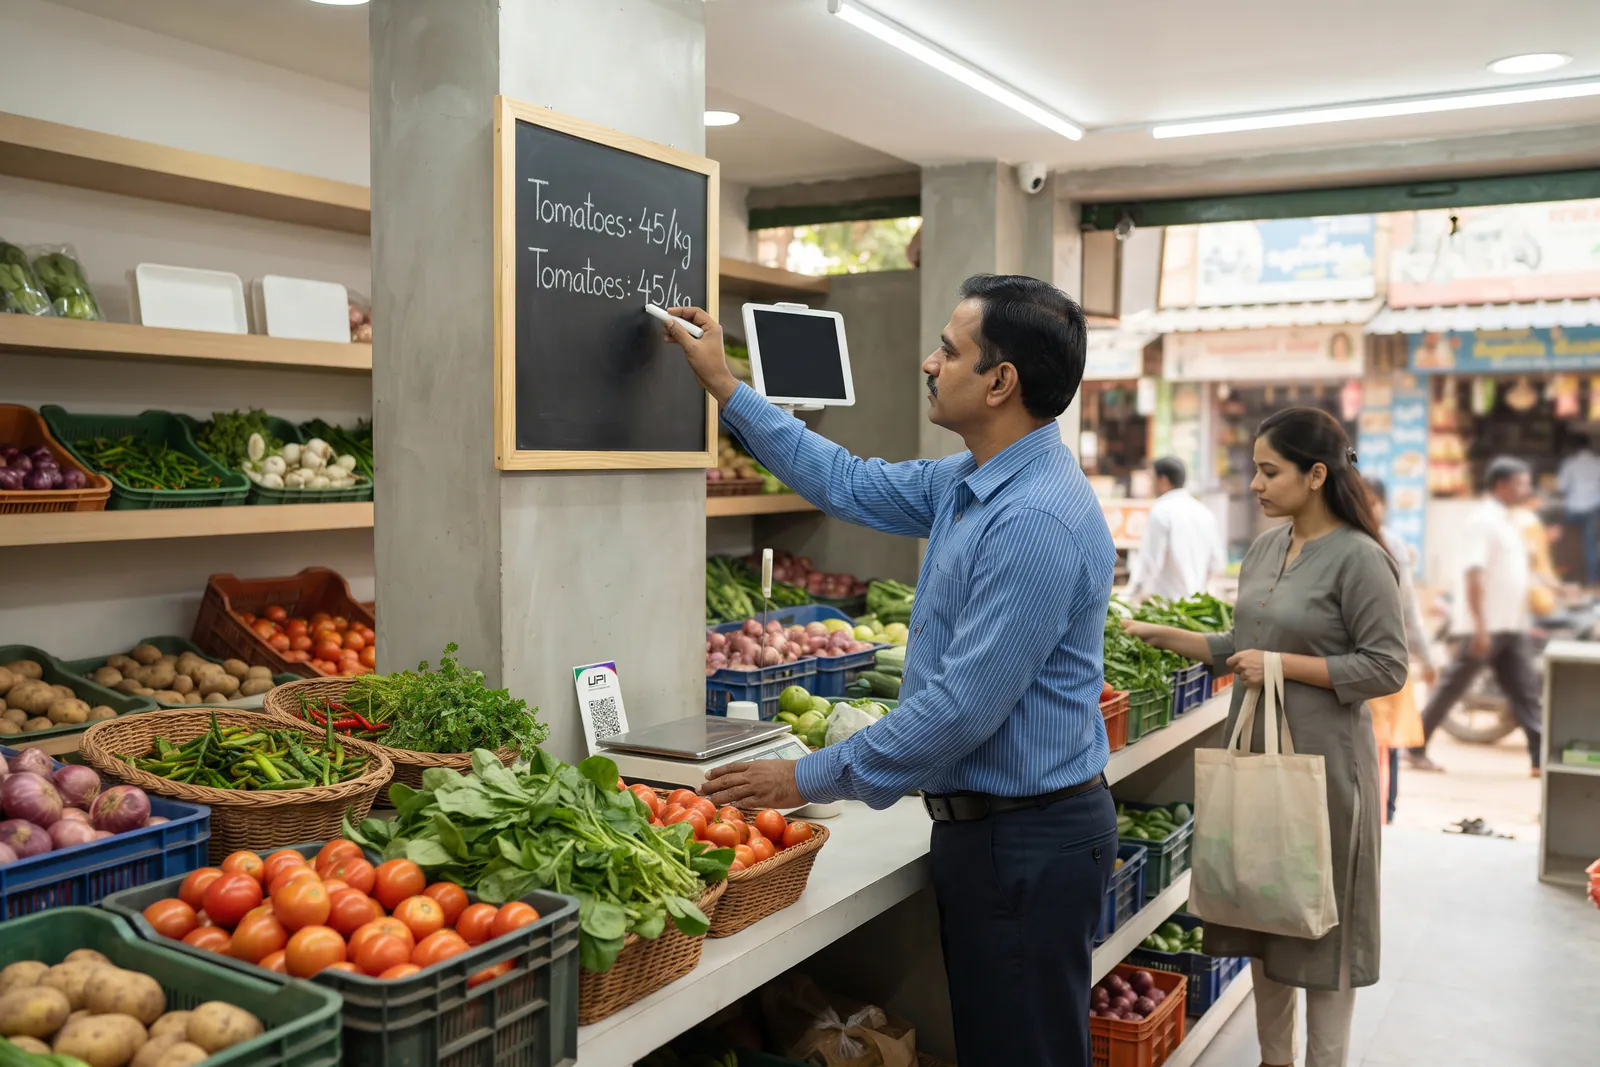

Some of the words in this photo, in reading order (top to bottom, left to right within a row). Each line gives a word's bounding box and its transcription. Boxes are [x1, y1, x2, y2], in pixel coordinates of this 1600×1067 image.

[528, 178, 633, 238] Tomatoes:
[638, 207, 692, 270] 45/kg
[528, 247, 632, 299] Tomatoes:
[588, 673, 607, 686] UPI
